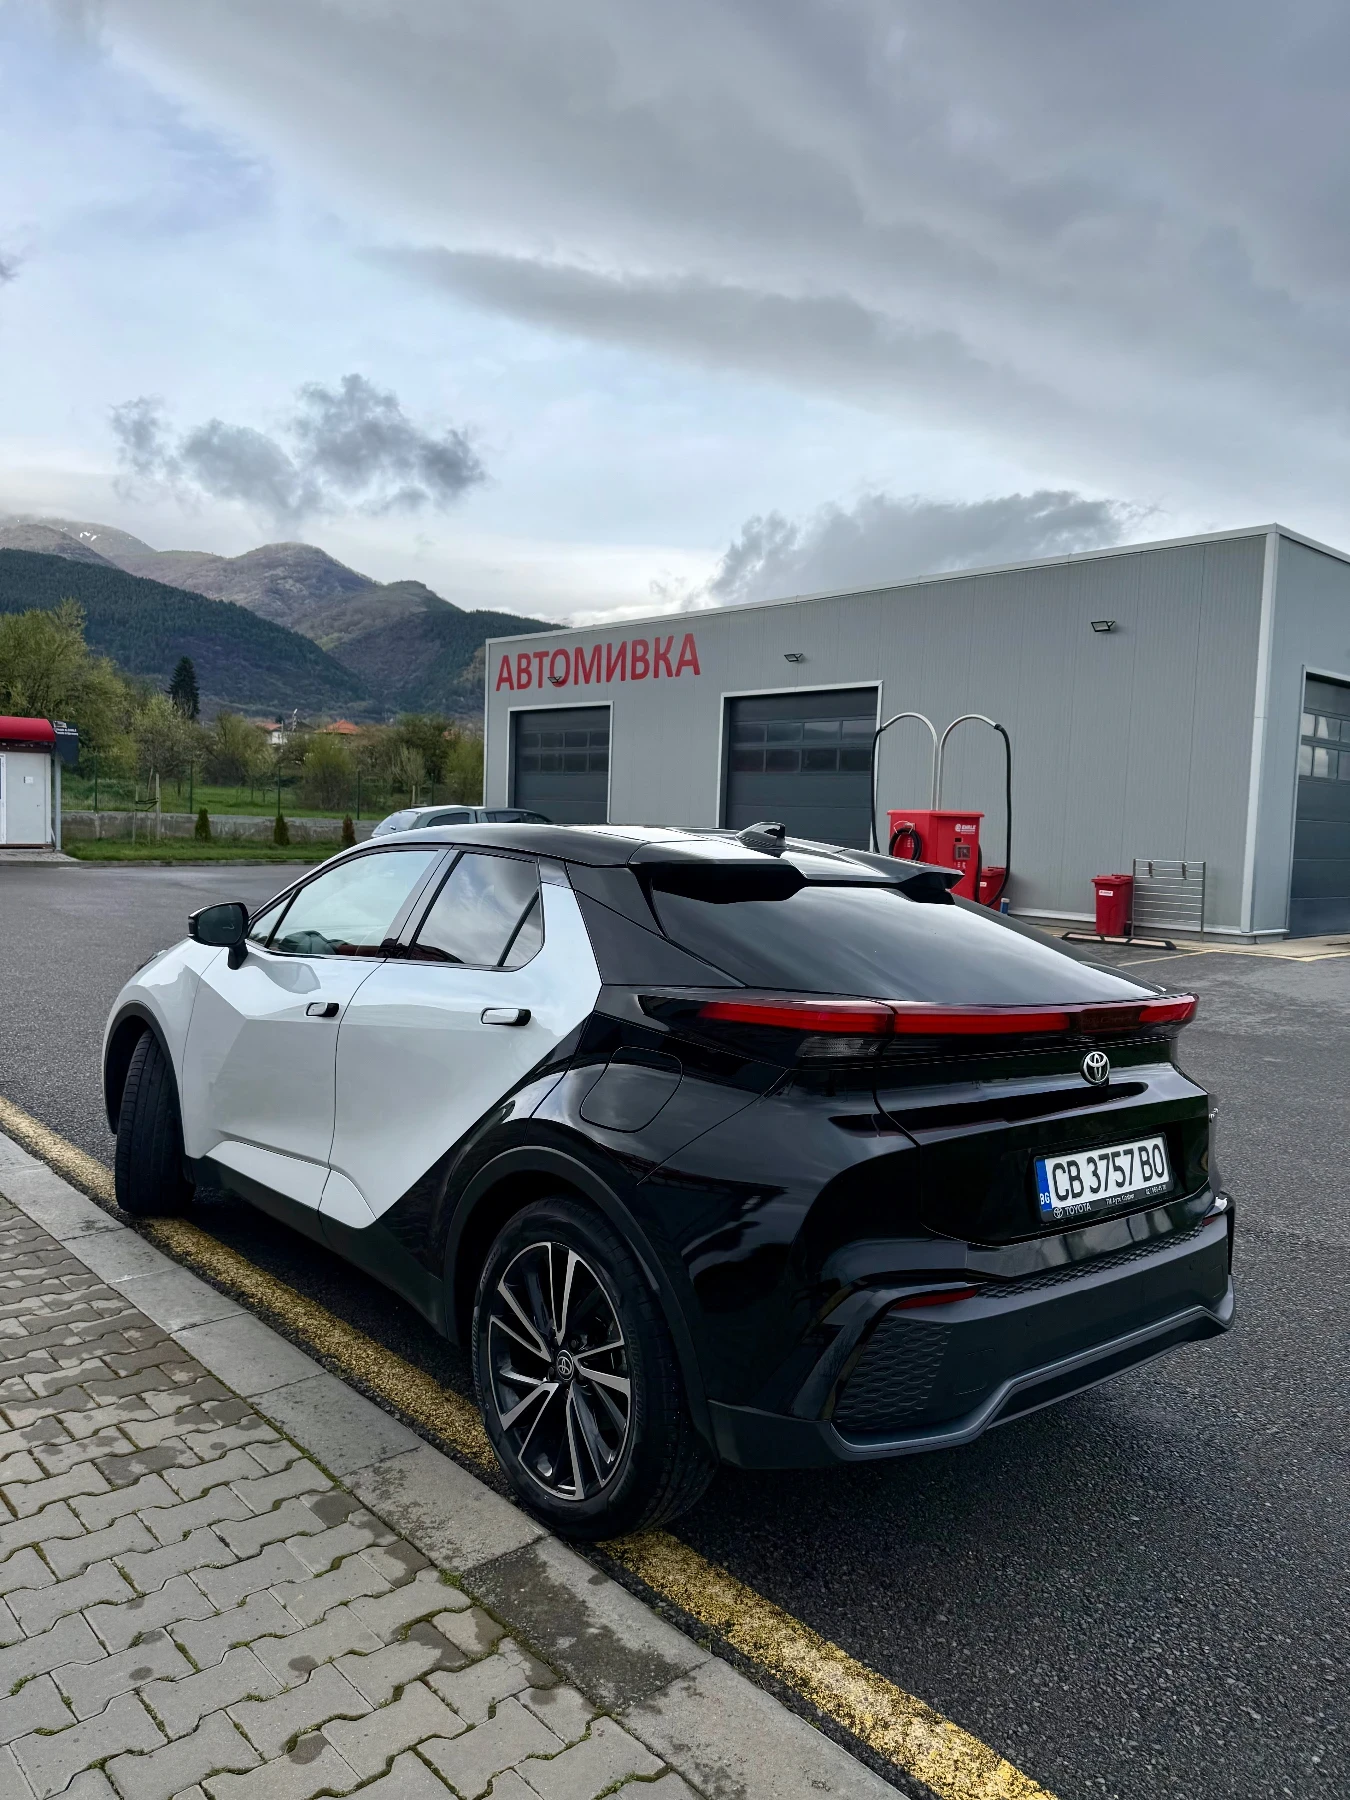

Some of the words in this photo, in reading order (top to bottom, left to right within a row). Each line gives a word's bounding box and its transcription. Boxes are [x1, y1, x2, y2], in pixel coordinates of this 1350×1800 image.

[496, 633, 700, 691] АВТОМИВКА
[1052, 1159, 1084, 1202] CB
[1086, 1148, 1135, 1194] 3757
[1138, 1143, 1165, 1183] BO
[1040, 1192, 1050, 1205] BG
[1065, 1203, 1091, 1215] TOYOTA
